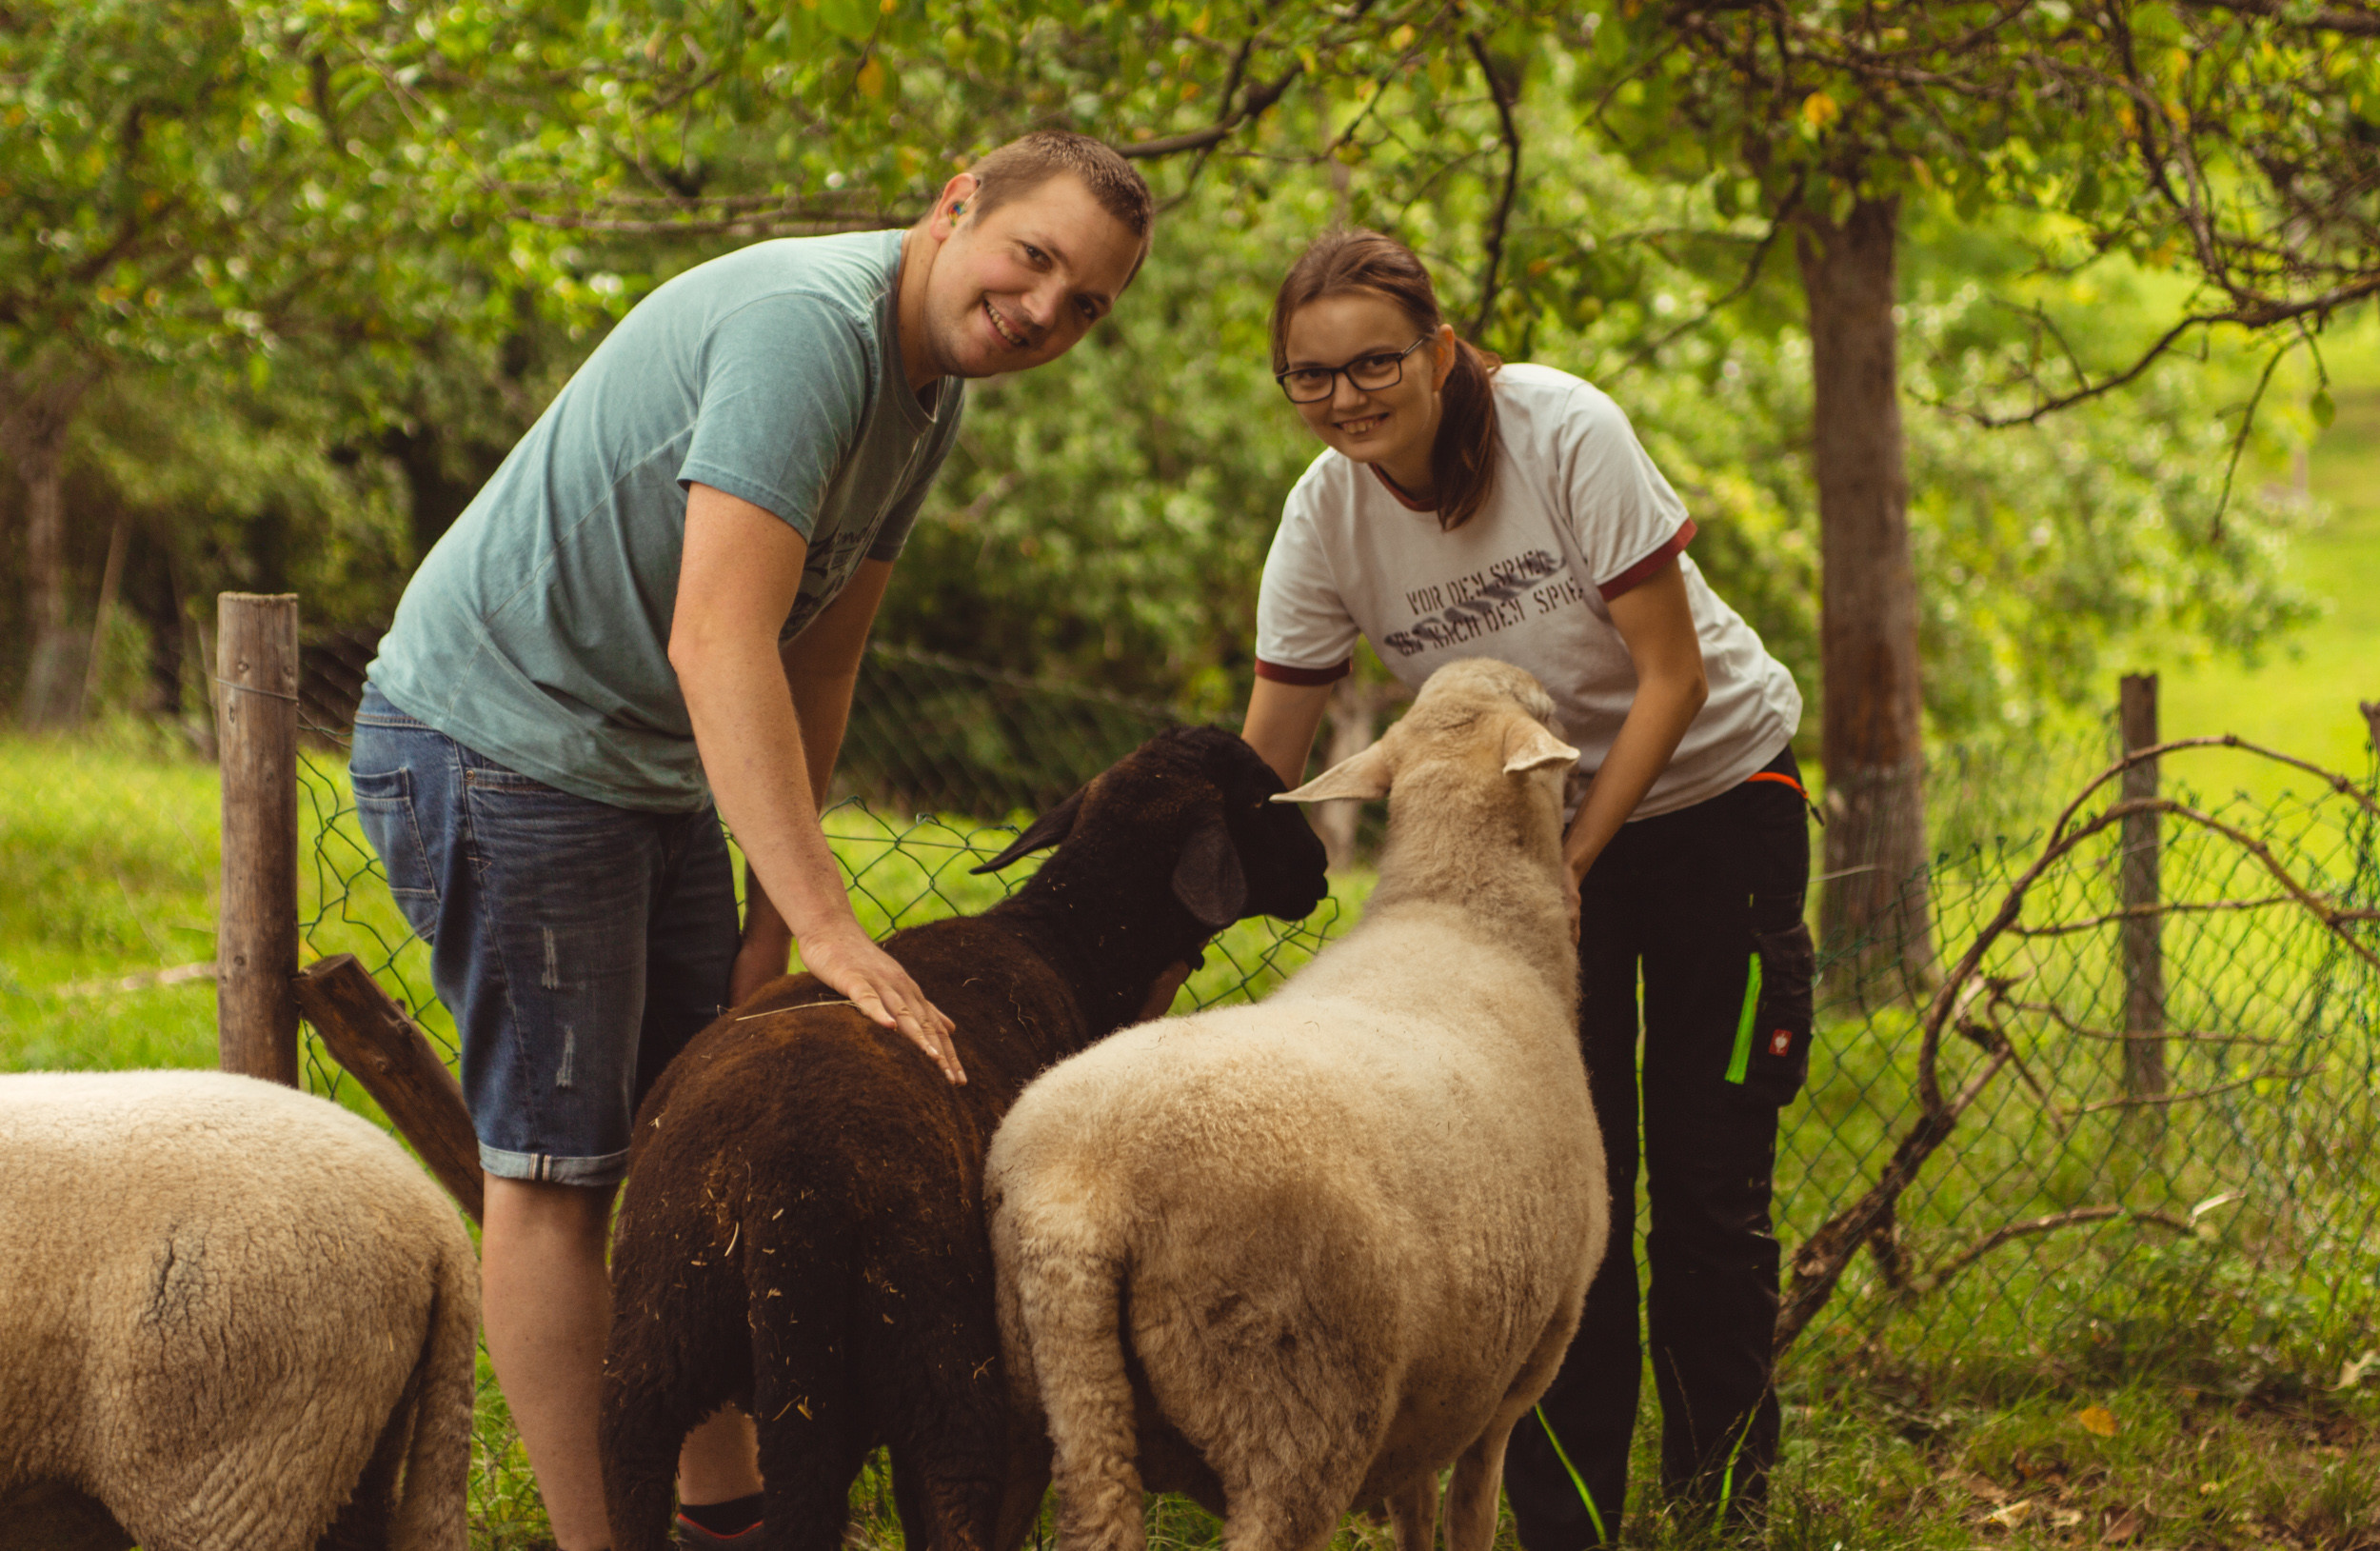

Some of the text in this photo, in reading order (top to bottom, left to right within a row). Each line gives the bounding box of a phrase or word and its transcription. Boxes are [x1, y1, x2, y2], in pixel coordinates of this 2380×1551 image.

[1405, 585, 1445, 615] VOR
[1446, 571, 1488, 606] DEM
[1428, 615, 1481, 649] NACH
[1485, 598, 1527, 633] DEM
[1533, 576, 1584, 615] SPIE
